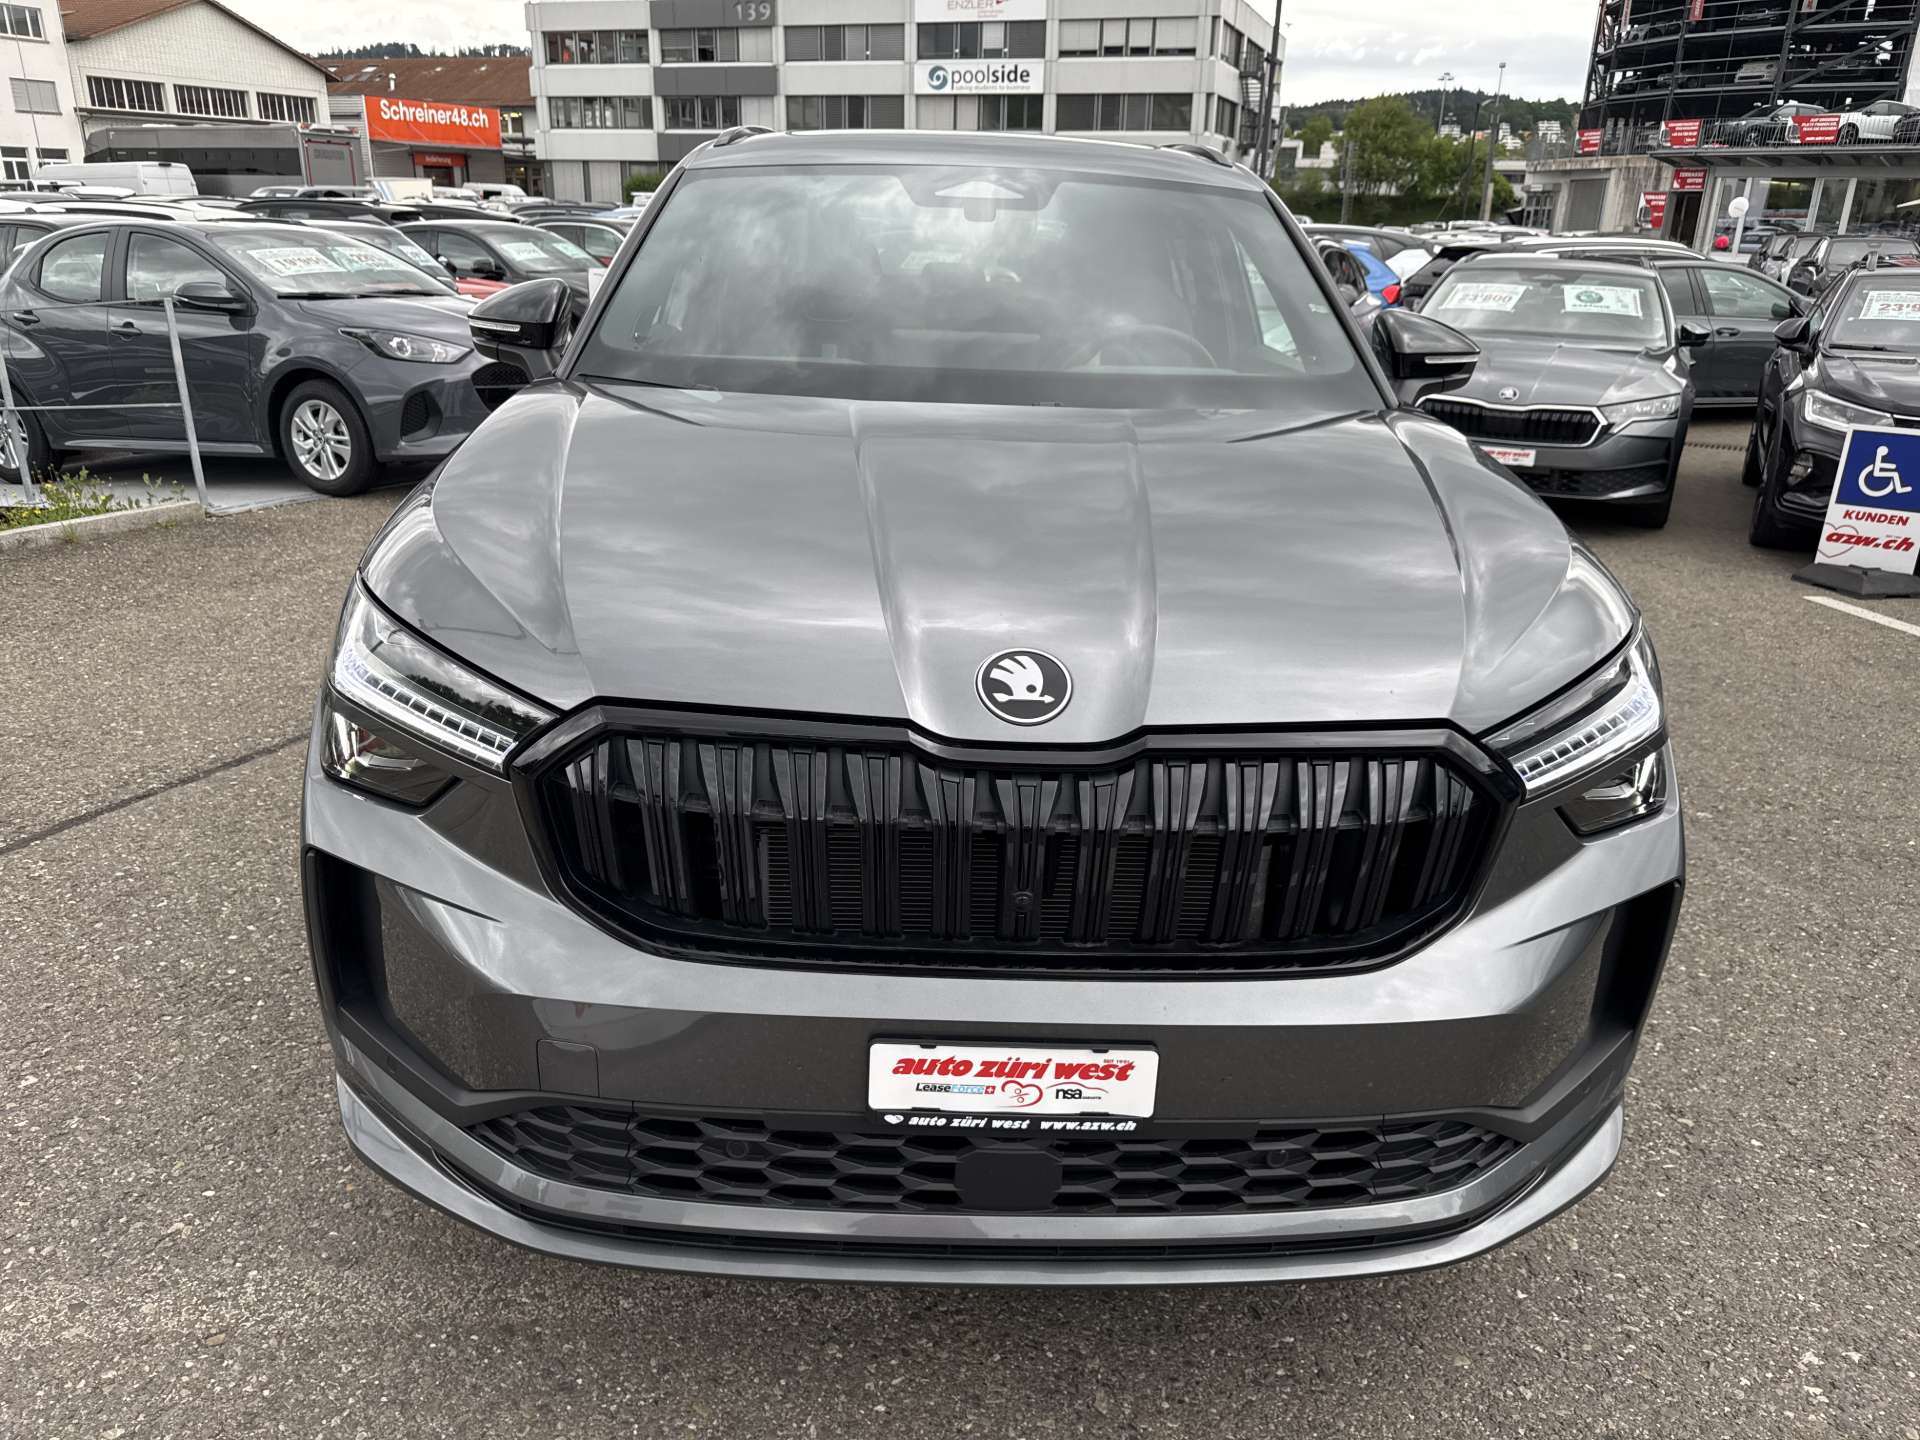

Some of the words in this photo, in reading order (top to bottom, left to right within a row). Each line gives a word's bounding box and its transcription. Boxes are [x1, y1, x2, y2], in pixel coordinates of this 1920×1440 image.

[735, 3, 770, 20] 139
[951, 64, 1030, 90] poolside
[380, 98, 489, 128] Schreiner48.ch
[1843, 510, 1910, 526] KUNDEN
[1826, 532, 1915, 551] azw.ch
[891, 1056, 974, 1076] auto
[974, 1057, 1052, 1079] züri
[1054, 1061, 1136, 1081] west
[1055, 1088, 1082, 1099] nsa
[908, 1116, 947, 1126] auto
[950, 1116, 987, 1128] züri
[992, 1119, 1030, 1129] west
[1040, 1120, 1137, 1131] www.azw.ch
